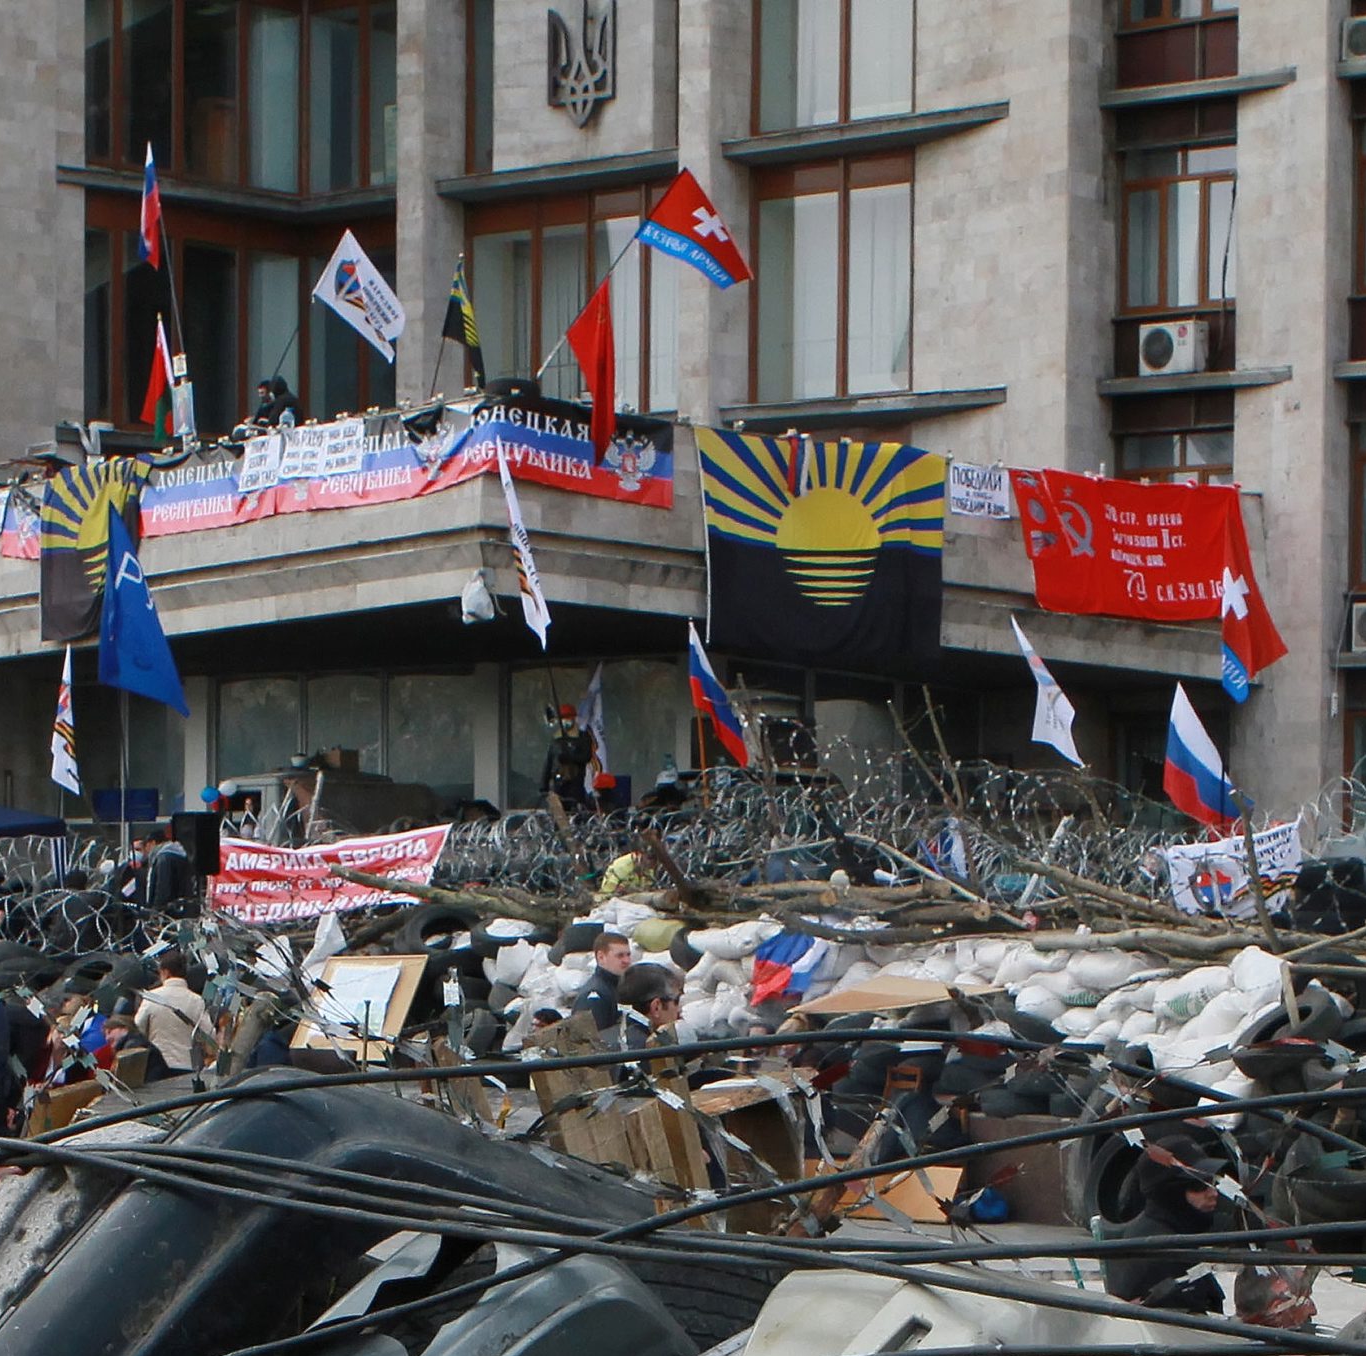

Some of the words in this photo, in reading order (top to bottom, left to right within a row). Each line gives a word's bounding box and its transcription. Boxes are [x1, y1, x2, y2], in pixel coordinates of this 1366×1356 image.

[155, 461, 235, 492] ДОНЕЦКАЯ
[319, 464, 412, 496] РЕСПУБЛИКА
[952, 466, 1002, 491] ПОБЕДИЛИ
[152, 494, 234, 524] РЕСПУБЛИКА
[337, 838, 428, 868] ЕВРОПА
